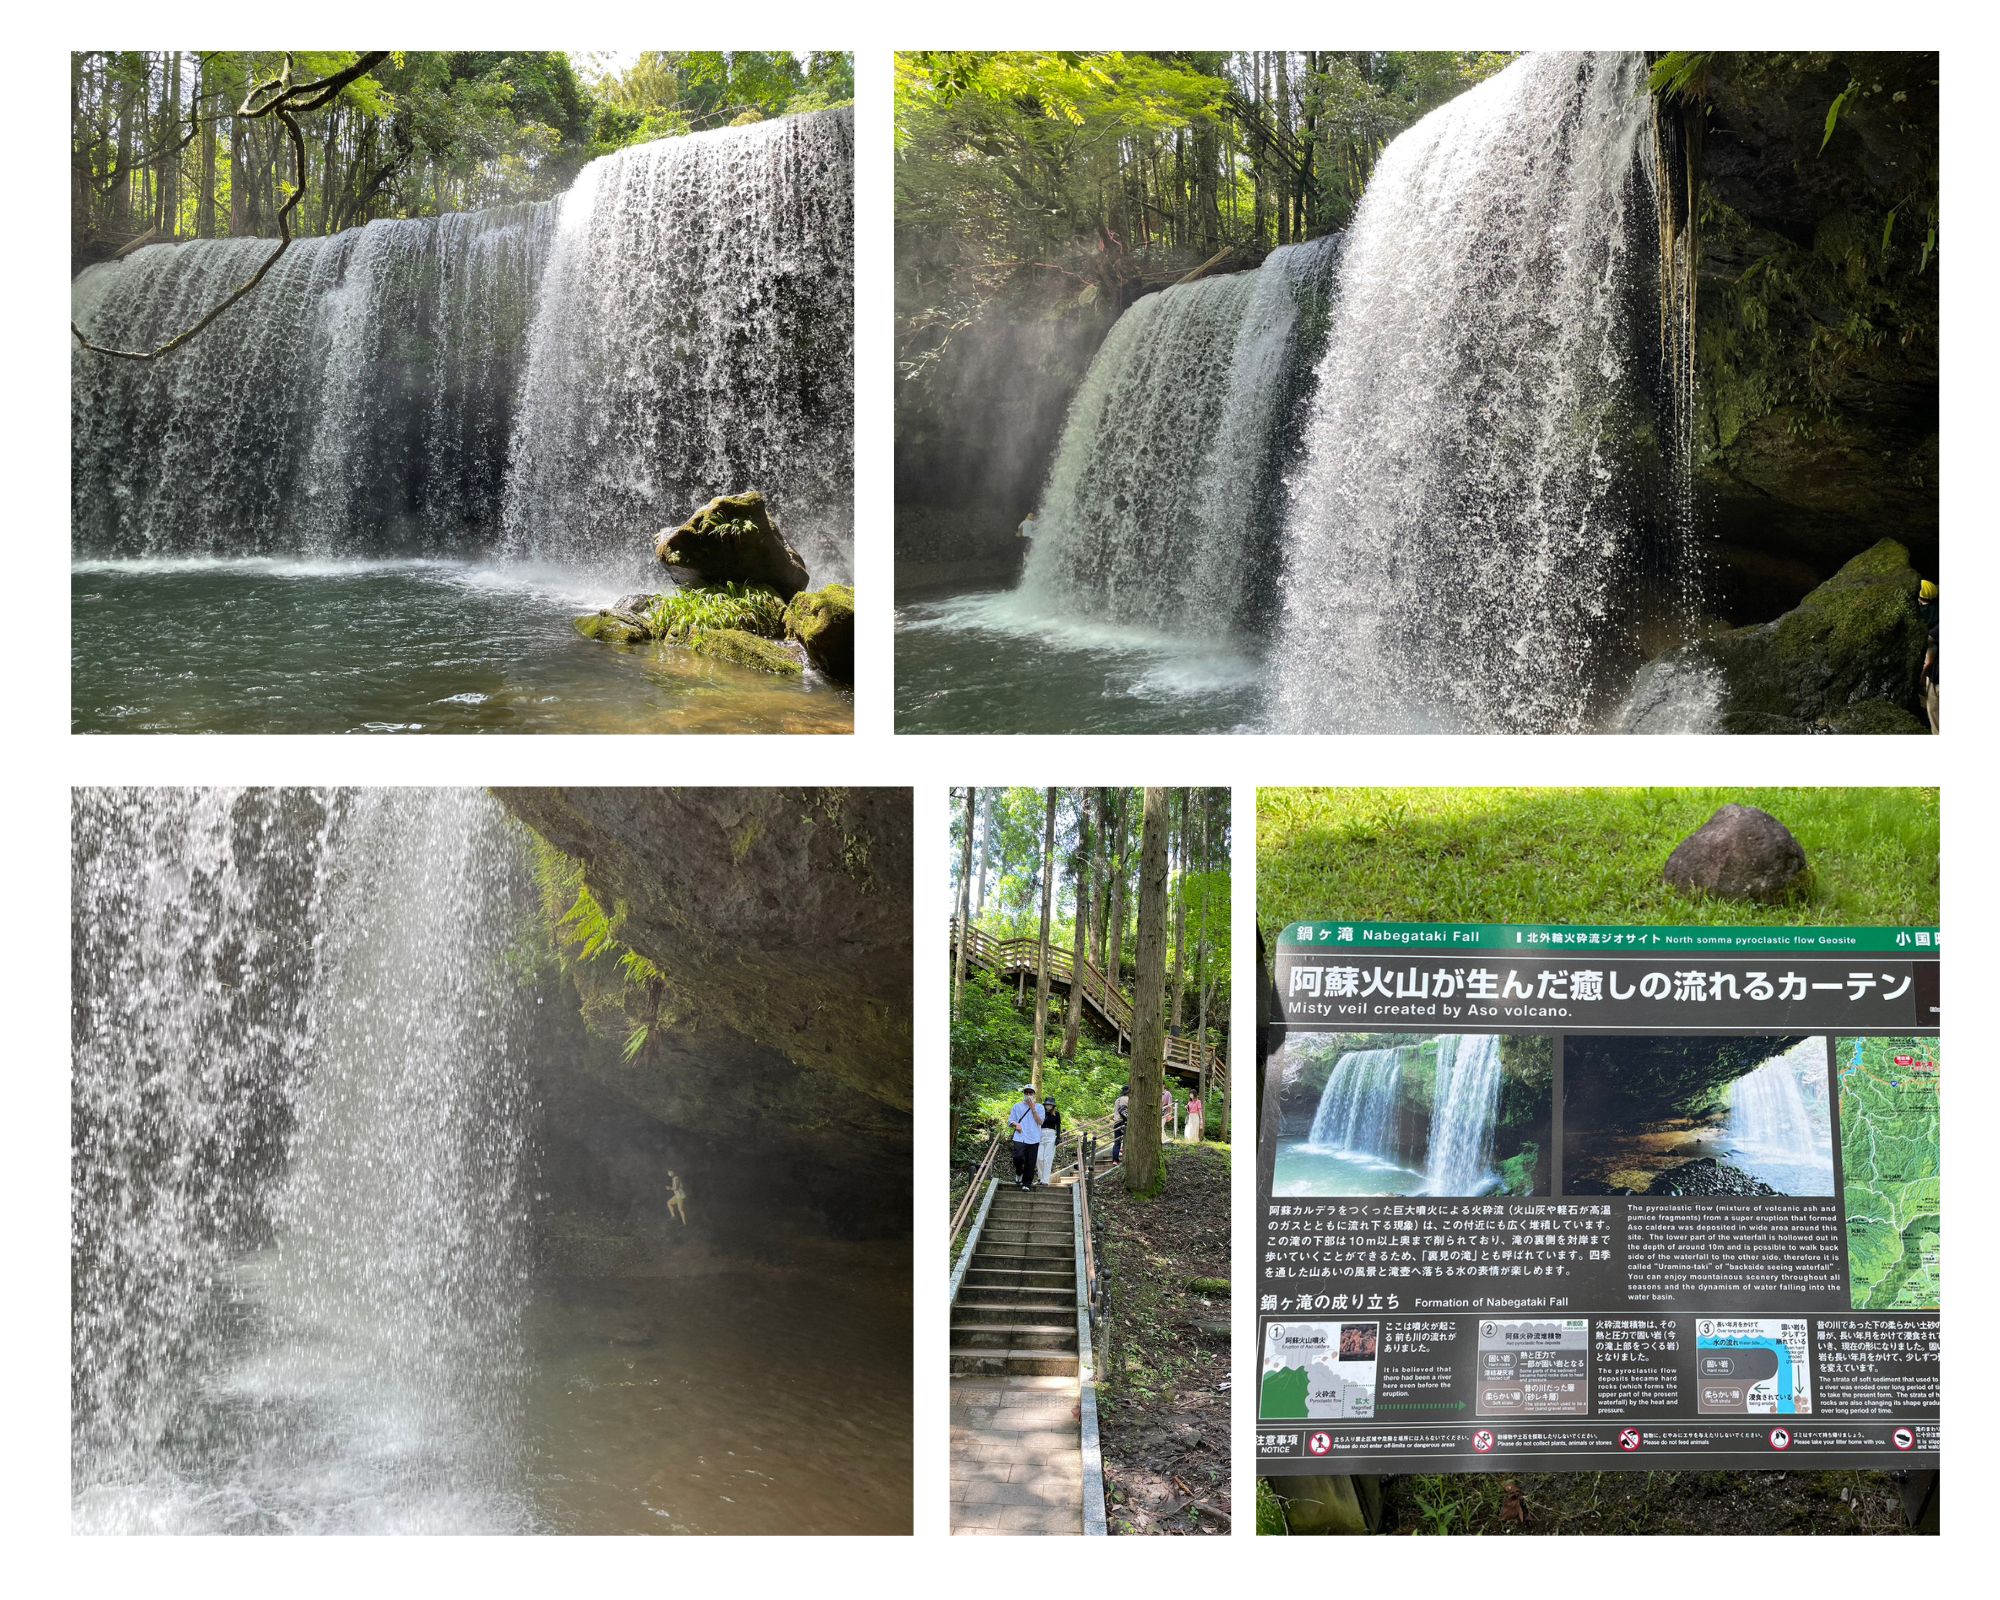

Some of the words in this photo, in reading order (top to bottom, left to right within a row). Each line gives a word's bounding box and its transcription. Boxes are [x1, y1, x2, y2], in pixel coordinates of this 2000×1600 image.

[1363, 930, 1446, 943] Nabegataki
[1453, 931, 1479, 942] Fall
[1527, 932, 1661, 944] 北外輪火砕流ジオサイト
[1736, 936, 1790, 945] pyroclastic
[1289, 966, 1912, 1001] 阿蘇火山が生んだ癒しの流れるカーテン
[1288, 1002, 1332, 1016] Misty
[1338, 1002, 1367, 1014] veil
[1374, 1003, 1436, 1015] created
[1443, 1004, 1461, 1018] by
[1468, 1004, 1498, 1016] Aso
[1504, 1005, 1572, 1017] volcano.
[1780, 1284, 1806, 1292] falling
[1260, 1294, 1400, 1311] 鍋ヶ滝の成り立ち
[1415, 1298, 1469, 1307] Formation
[1473, 1298, 1484, 1307] of
[1487, 1297, 1546, 1309] Nabegataki
[1550, 1297, 1568, 1306] Fall
[1386, 1322, 1456, 1331] ここは噴火が起こ
[1596, 1320, 1676, 1329] 火砕流堆積物は、その
[1384, 1344, 1431, 1353] ありました。
[1596, 1353, 1650, 1362] となりました。
[1820, 1364, 1879, 1372] を変えています。
[1486, 1392, 1520, 1400] 柔らかい層
[1705, 1391, 1739, 1399] 柔らかい層
